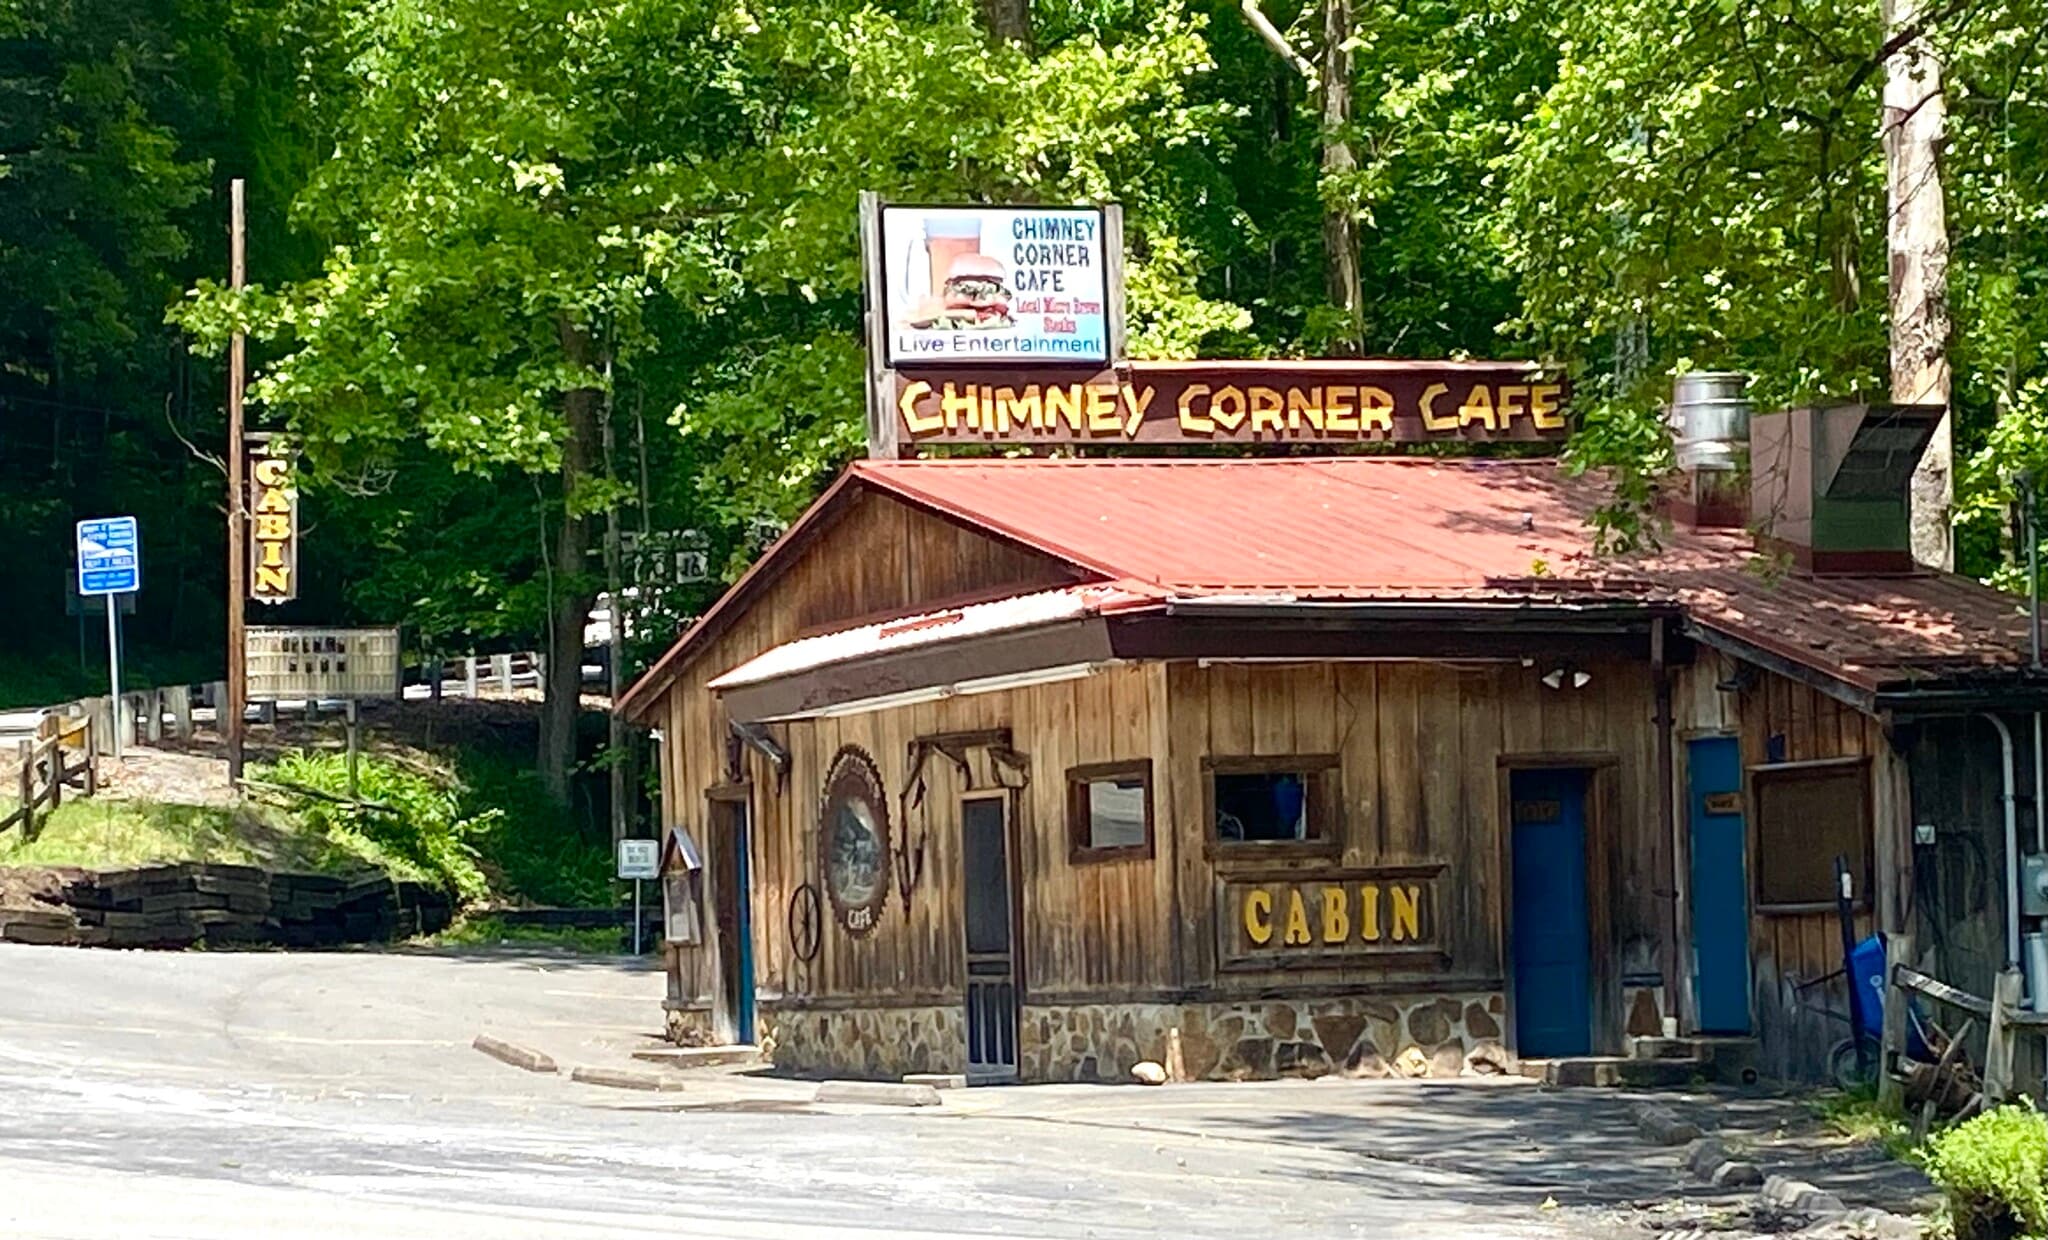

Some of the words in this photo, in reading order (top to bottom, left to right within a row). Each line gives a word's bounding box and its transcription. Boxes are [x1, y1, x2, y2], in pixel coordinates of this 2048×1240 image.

[1012, 217, 1095, 241] CHIMNEY
[1013, 243, 1090, 267] CORNER
[1015, 269, 1065, 292] CAFE
[899, 335, 944, 352] Live
[953, 335, 1102, 353] Entertainment
[899, 380, 1155, 439] CHIMNEY
[1178, 383, 1395, 439] CORNER
[1418, 382, 1566, 433] CAFE
[255, 459, 291, 594] CABIN
[1244, 885, 1421, 944] CABIN
